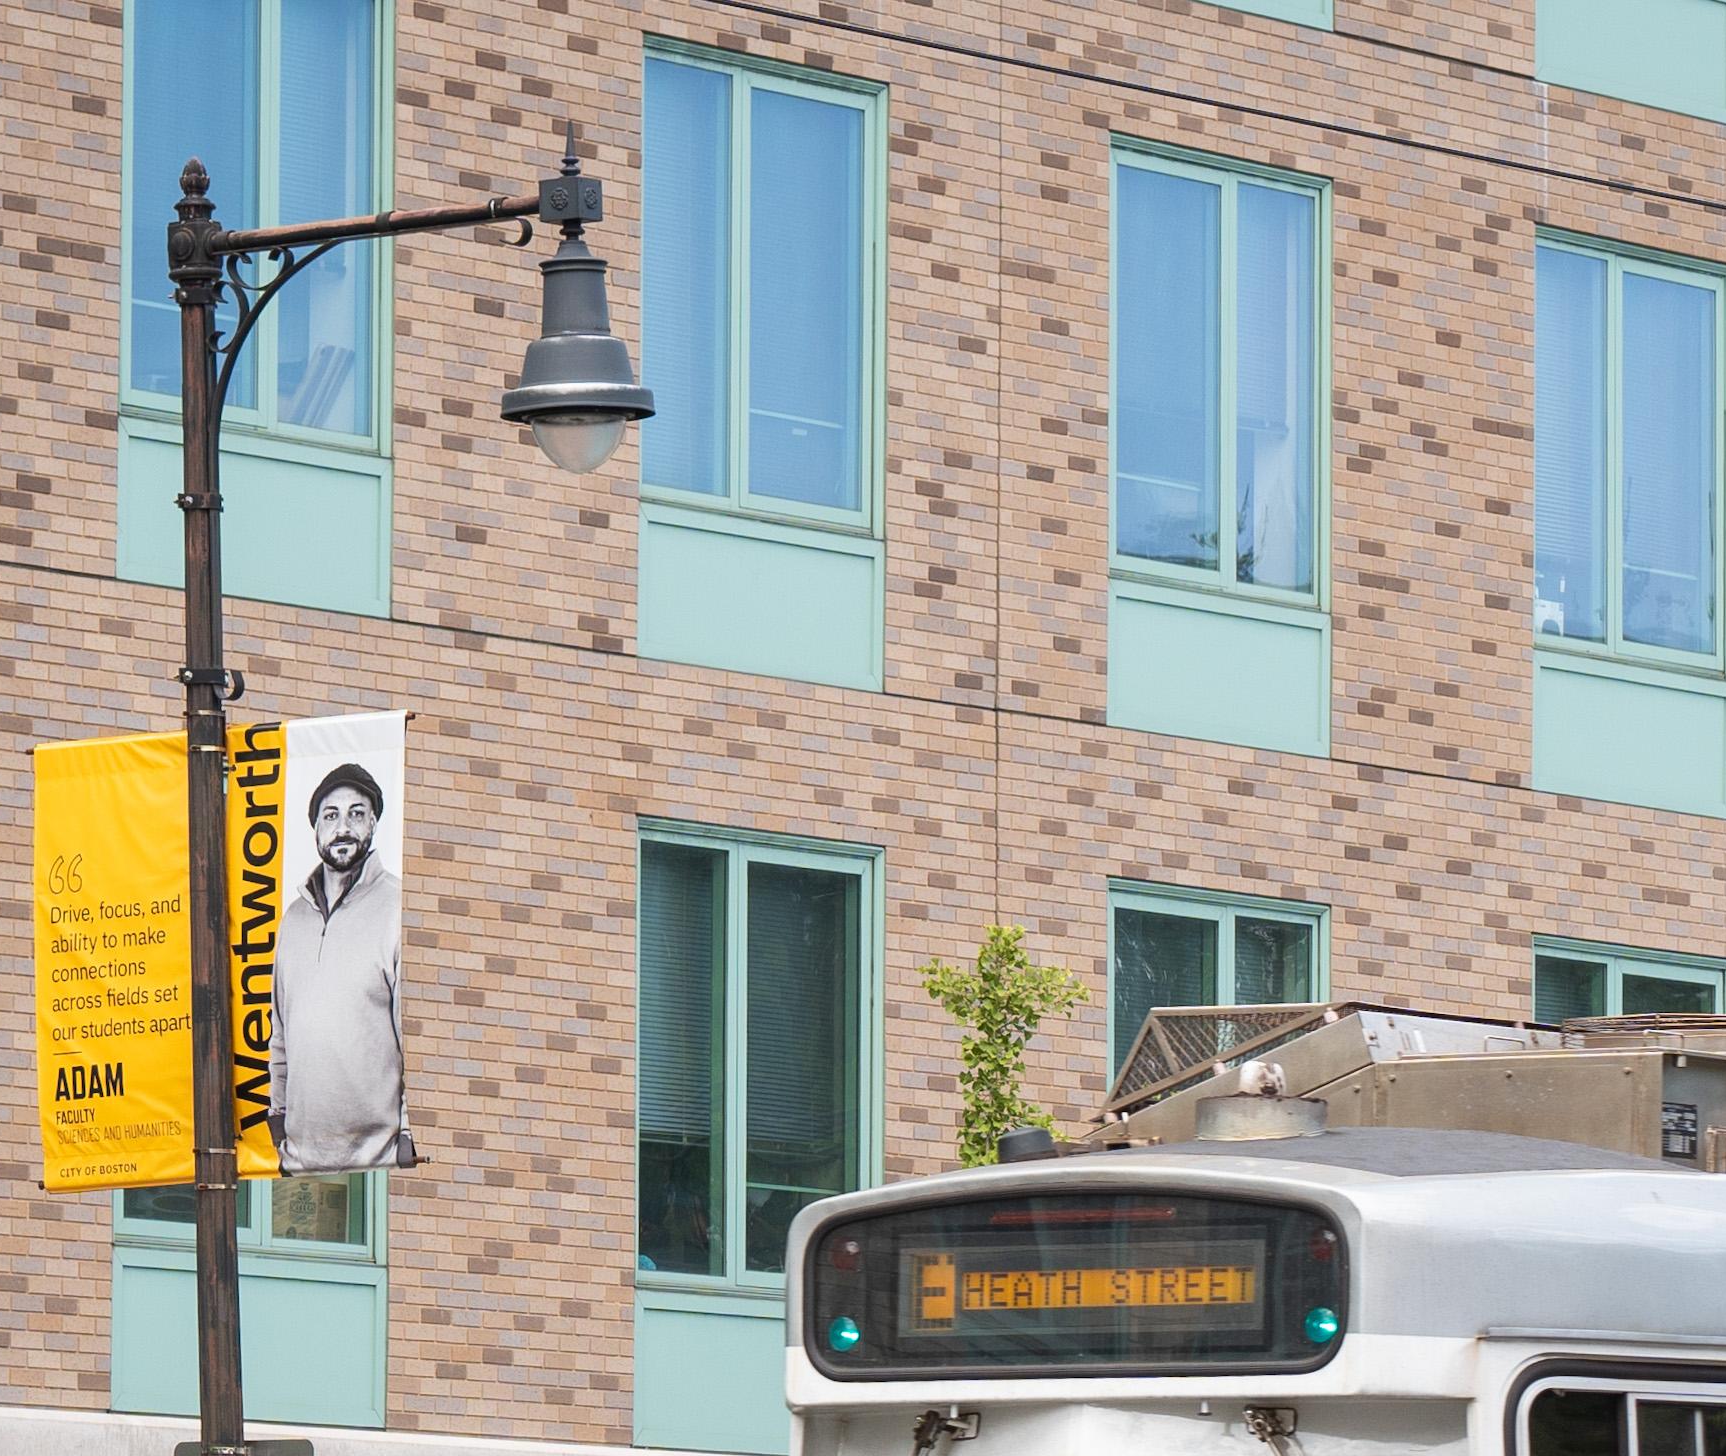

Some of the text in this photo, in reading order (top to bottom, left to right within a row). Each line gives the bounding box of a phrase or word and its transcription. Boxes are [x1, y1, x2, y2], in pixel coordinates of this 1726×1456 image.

[50, 894, 181, 924] Drive, focus, and
[231, 721, 282, 1131] Wentworth
[51, 926, 166, 955] ability to make
[51, 959, 146, 983] connections
[52, 985, 178, 1012] across fields set
[52, 1013, 192, 1041] our students apart
[55, 1063, 124, 1102] ADAM
[56, 1108, 95, 1125] FACULTY
[57, 1121, 182, 1144] SCIENCES AND HUMANITIES
[60, 1163, 137, 1178] CITY OF BOSTON
[964, 1271, 1083, 1309] HEATH
[1110, 1266, 1254, 1304] STREET
